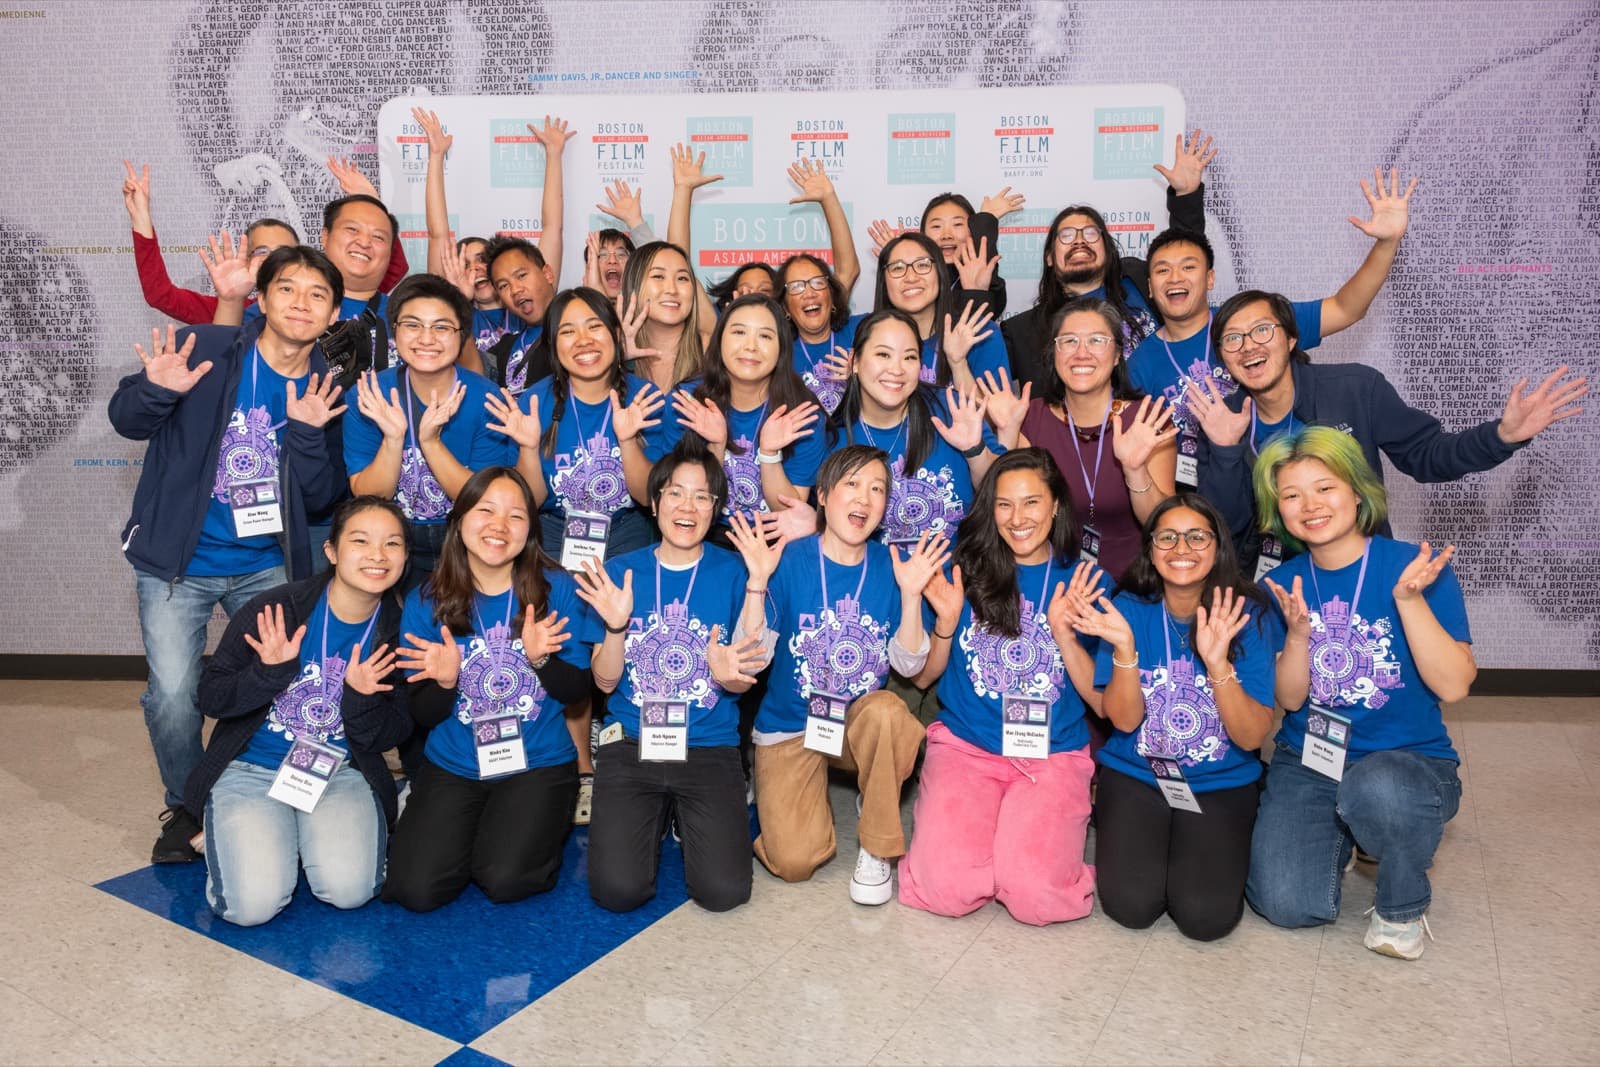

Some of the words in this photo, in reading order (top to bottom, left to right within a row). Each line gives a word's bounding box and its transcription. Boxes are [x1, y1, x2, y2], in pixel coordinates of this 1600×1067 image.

[276, 46, 302, 54] DANCE
[305, 45, 333, 53] COMIC
[279, 54, 302, 62] IRISH
[327, 61, 400, 69] IMPERSONATIONS
[409, 60, 445, 68] EVERETT
[605, 72, 640, 80] DANCER
[664, 71, 698, 79] SINGER
[797, 121, 844, 131] BOSTON
[1001, 116, 1048, 127] BOSTON
[402, 124, 447, 134] BOSN
[598, 123, 644, 134] BOSTON
[1000, 136, 1049, 153] FILM
[1104, 133, 1154, 151] FILM
[598, 144, 644, 160] FILM
[797, 141, 844, 157] FILM
[897, 139, 946, 156] FILM
[1000, 155, 1048, 164] FESTIVAL
[598, 161, 644, 169] FESTIVAL
[1103, 212, 1150, 222] BOSTON
[502, 219, 539, 229] BOSTO
[713, 217, 826, 243] BOSTON
[713, 252, 753, 264] ASIAN
